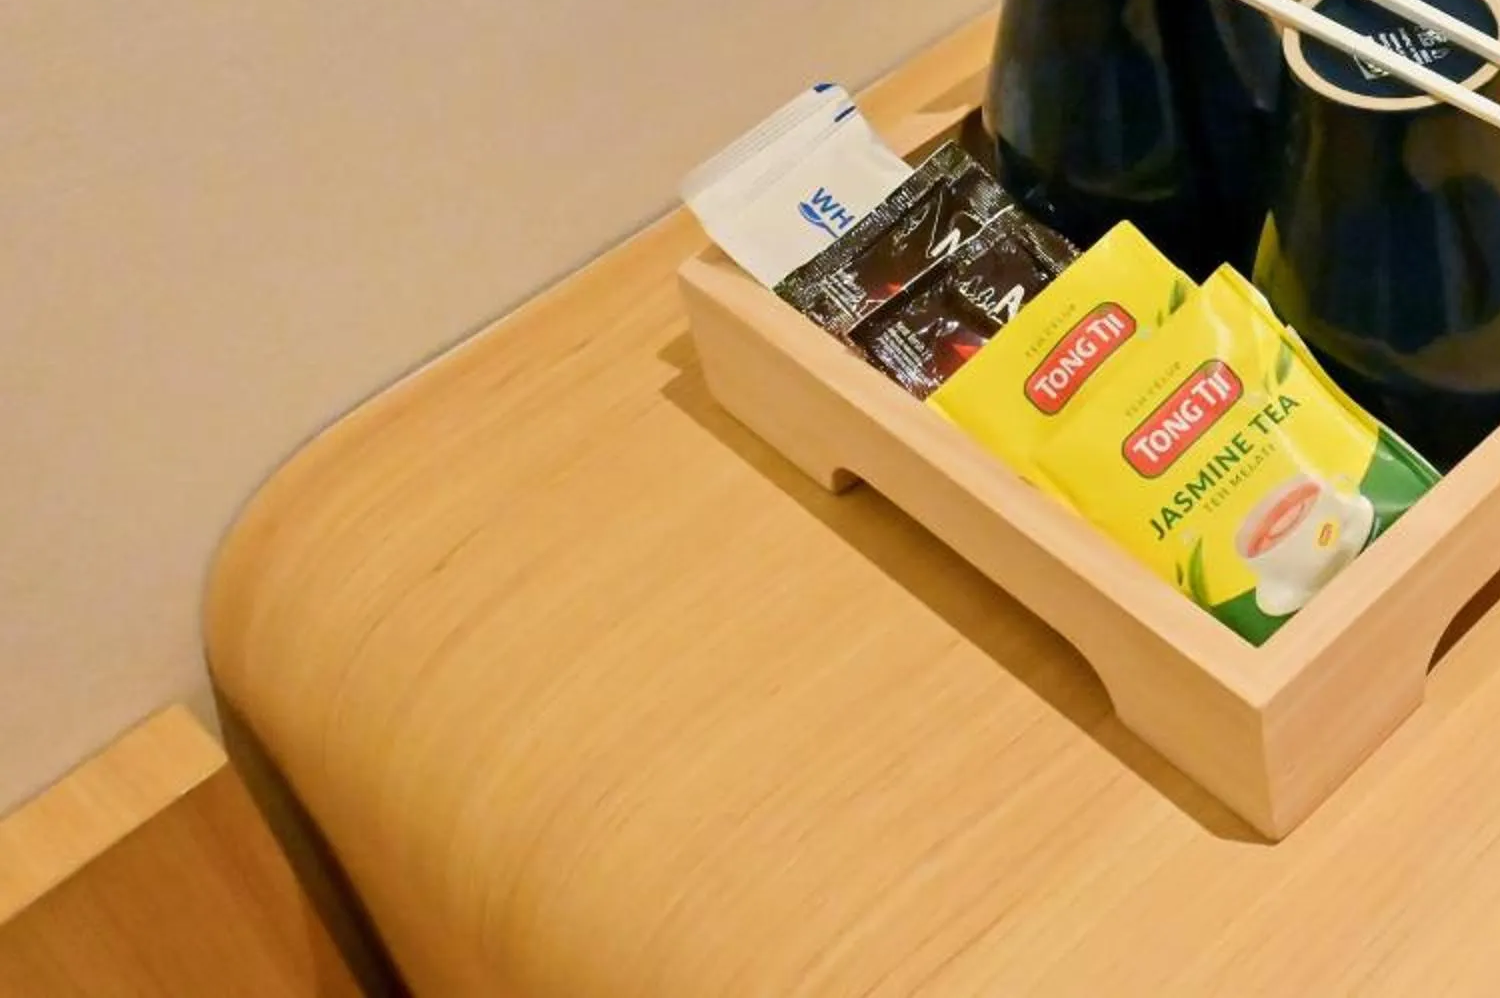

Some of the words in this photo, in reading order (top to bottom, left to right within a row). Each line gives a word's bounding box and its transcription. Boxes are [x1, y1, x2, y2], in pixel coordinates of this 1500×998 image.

[1034, 336, 1098, 400] TONG
[1085, 312, 1126, 343] TJI
[1132, 398, 1205, 464] TONG
[1190, 371, 1233, 408] TJI
[1149, 432, 1256, 542] JASMINE
[1247, 394, 1303, 435] TEA
